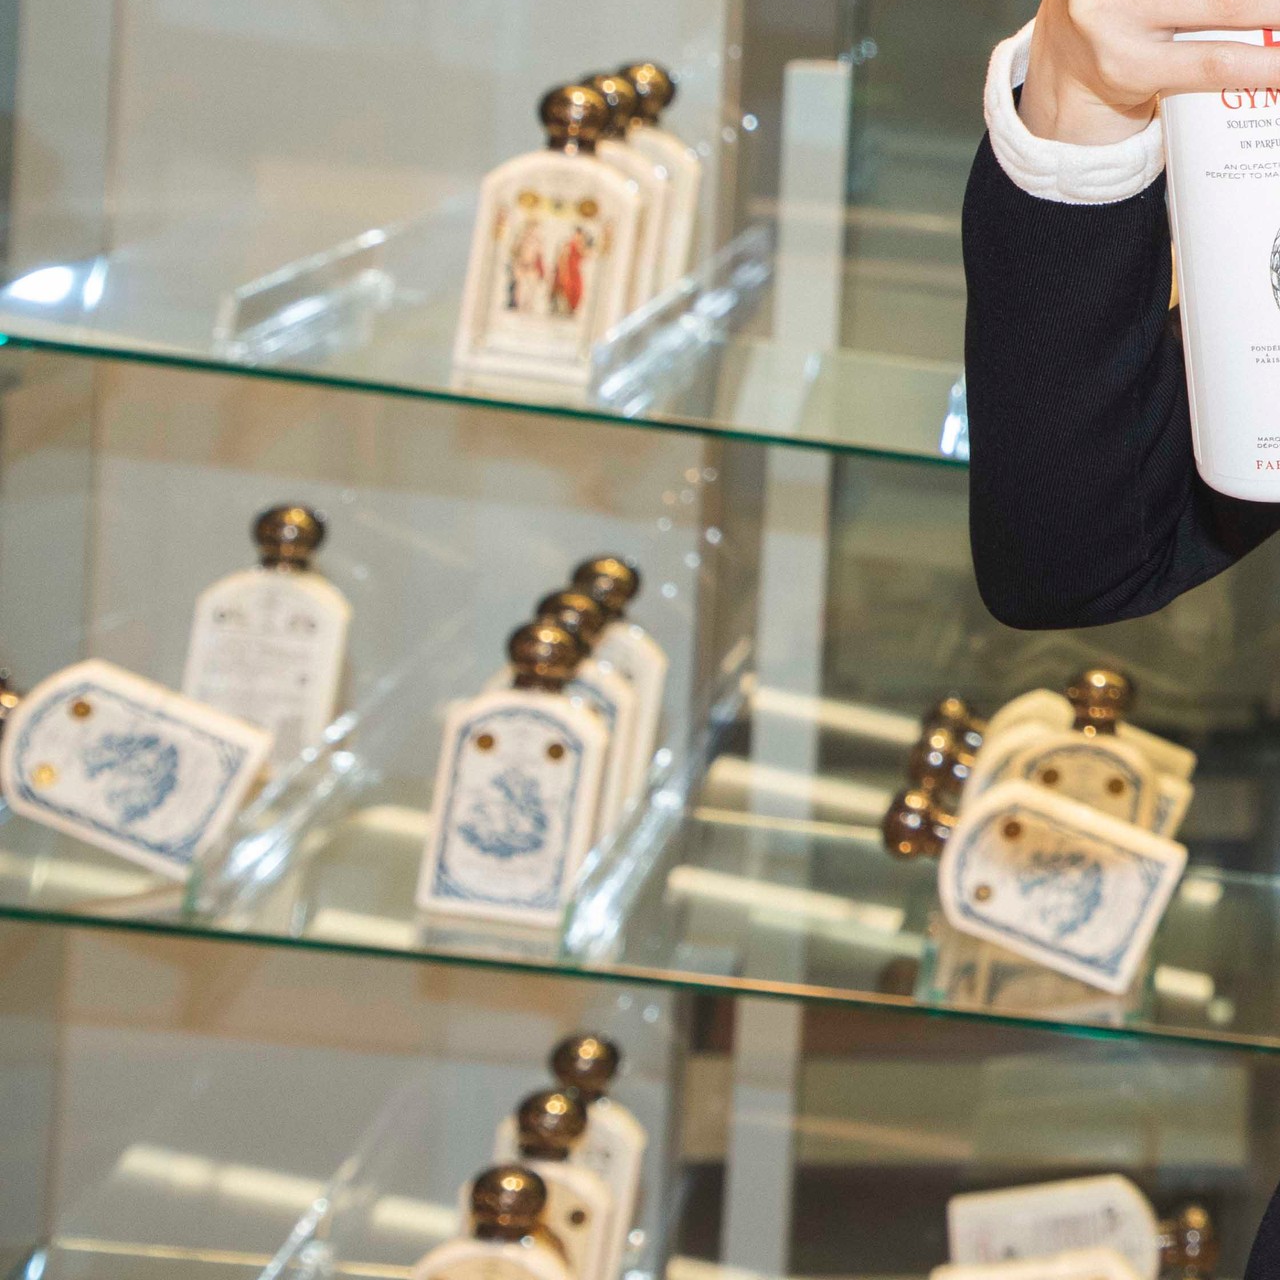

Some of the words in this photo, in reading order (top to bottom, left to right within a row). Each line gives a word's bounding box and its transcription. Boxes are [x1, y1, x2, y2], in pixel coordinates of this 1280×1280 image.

[1227, 119, 1272, 129] SOLUTION
[1240, 140, 1252, 149] UN
[1223, 163, 1238, 171] AN
[1205, 171, 1246, 179] PERFECT
